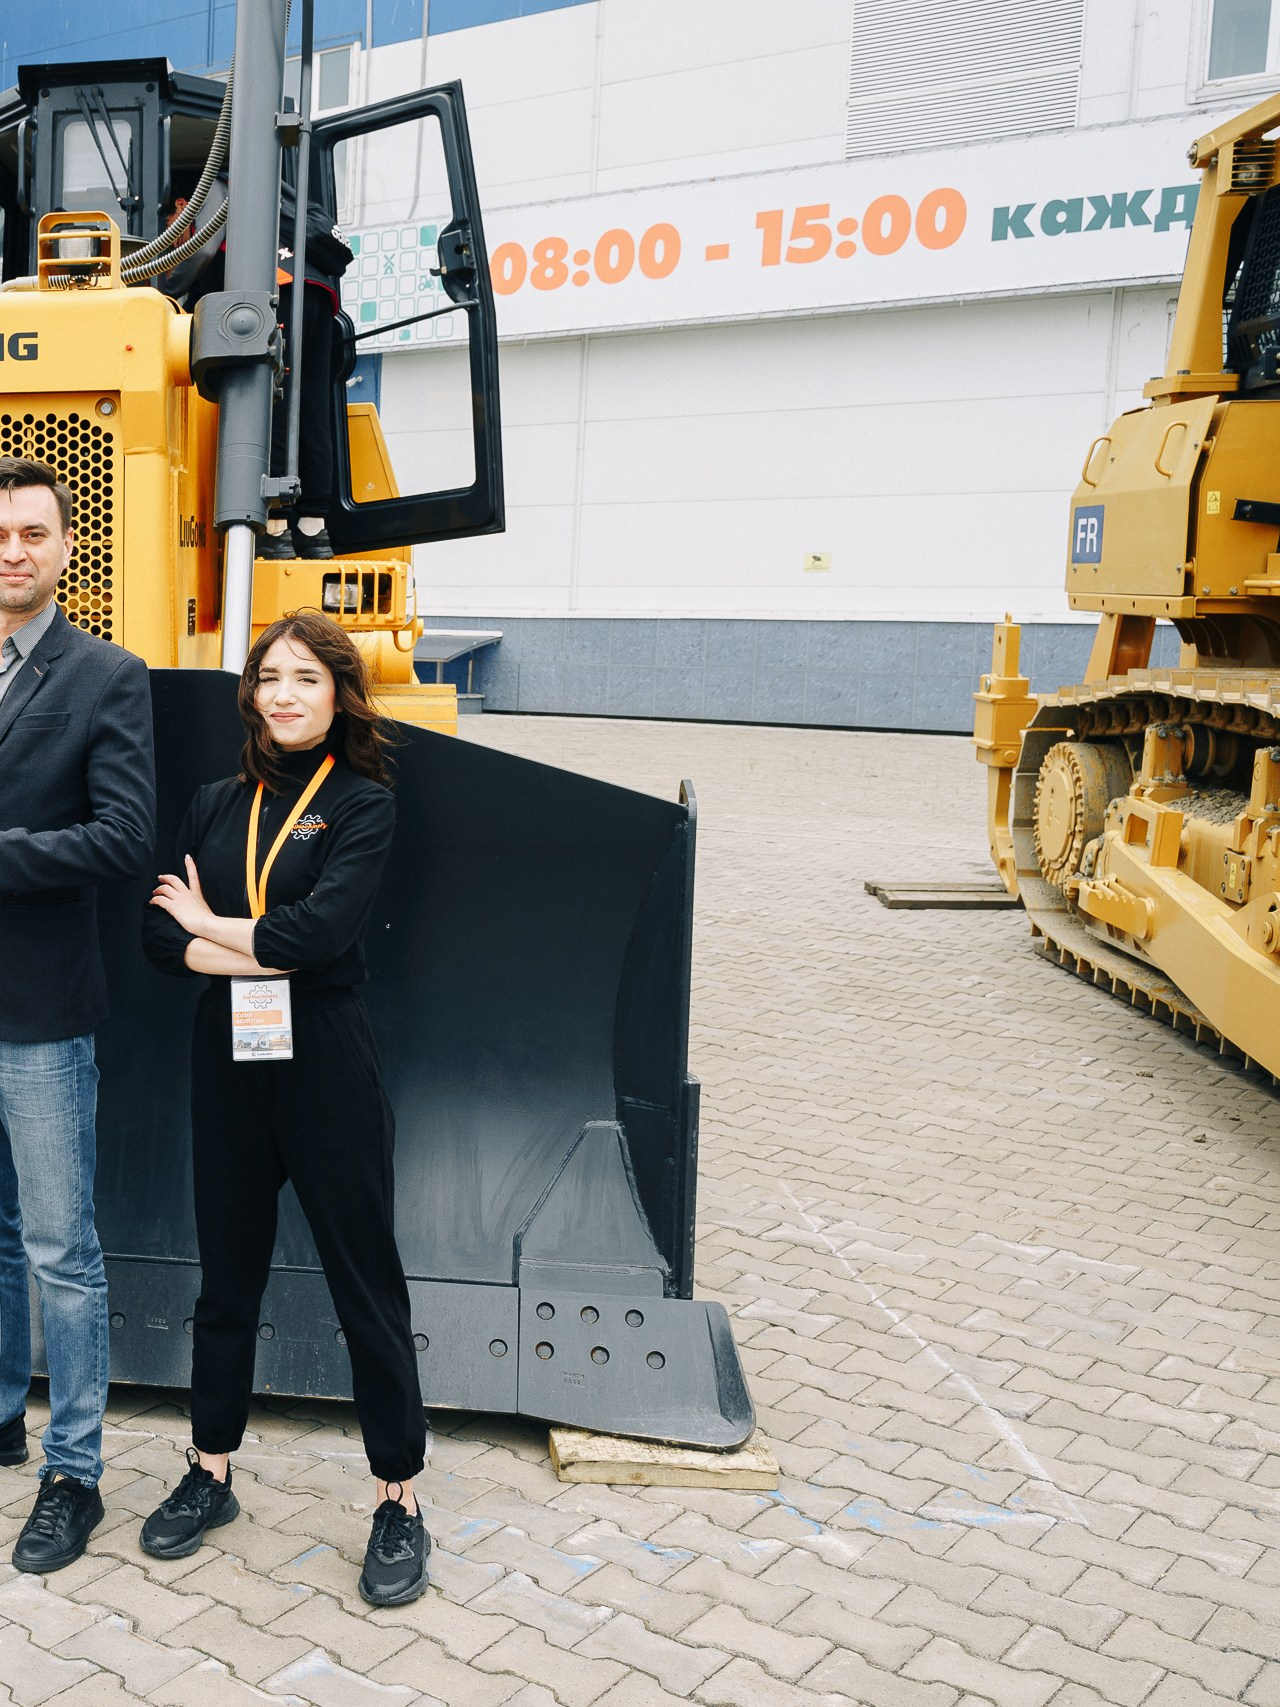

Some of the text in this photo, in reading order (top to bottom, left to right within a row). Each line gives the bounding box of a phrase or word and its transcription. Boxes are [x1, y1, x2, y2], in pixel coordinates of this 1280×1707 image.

[490, 223, 681, 296] 08:00
[705, 243, 730, 262] -
[755, 187, 967, 267] 15:00
[1076, 517, 1098, 554] FR
